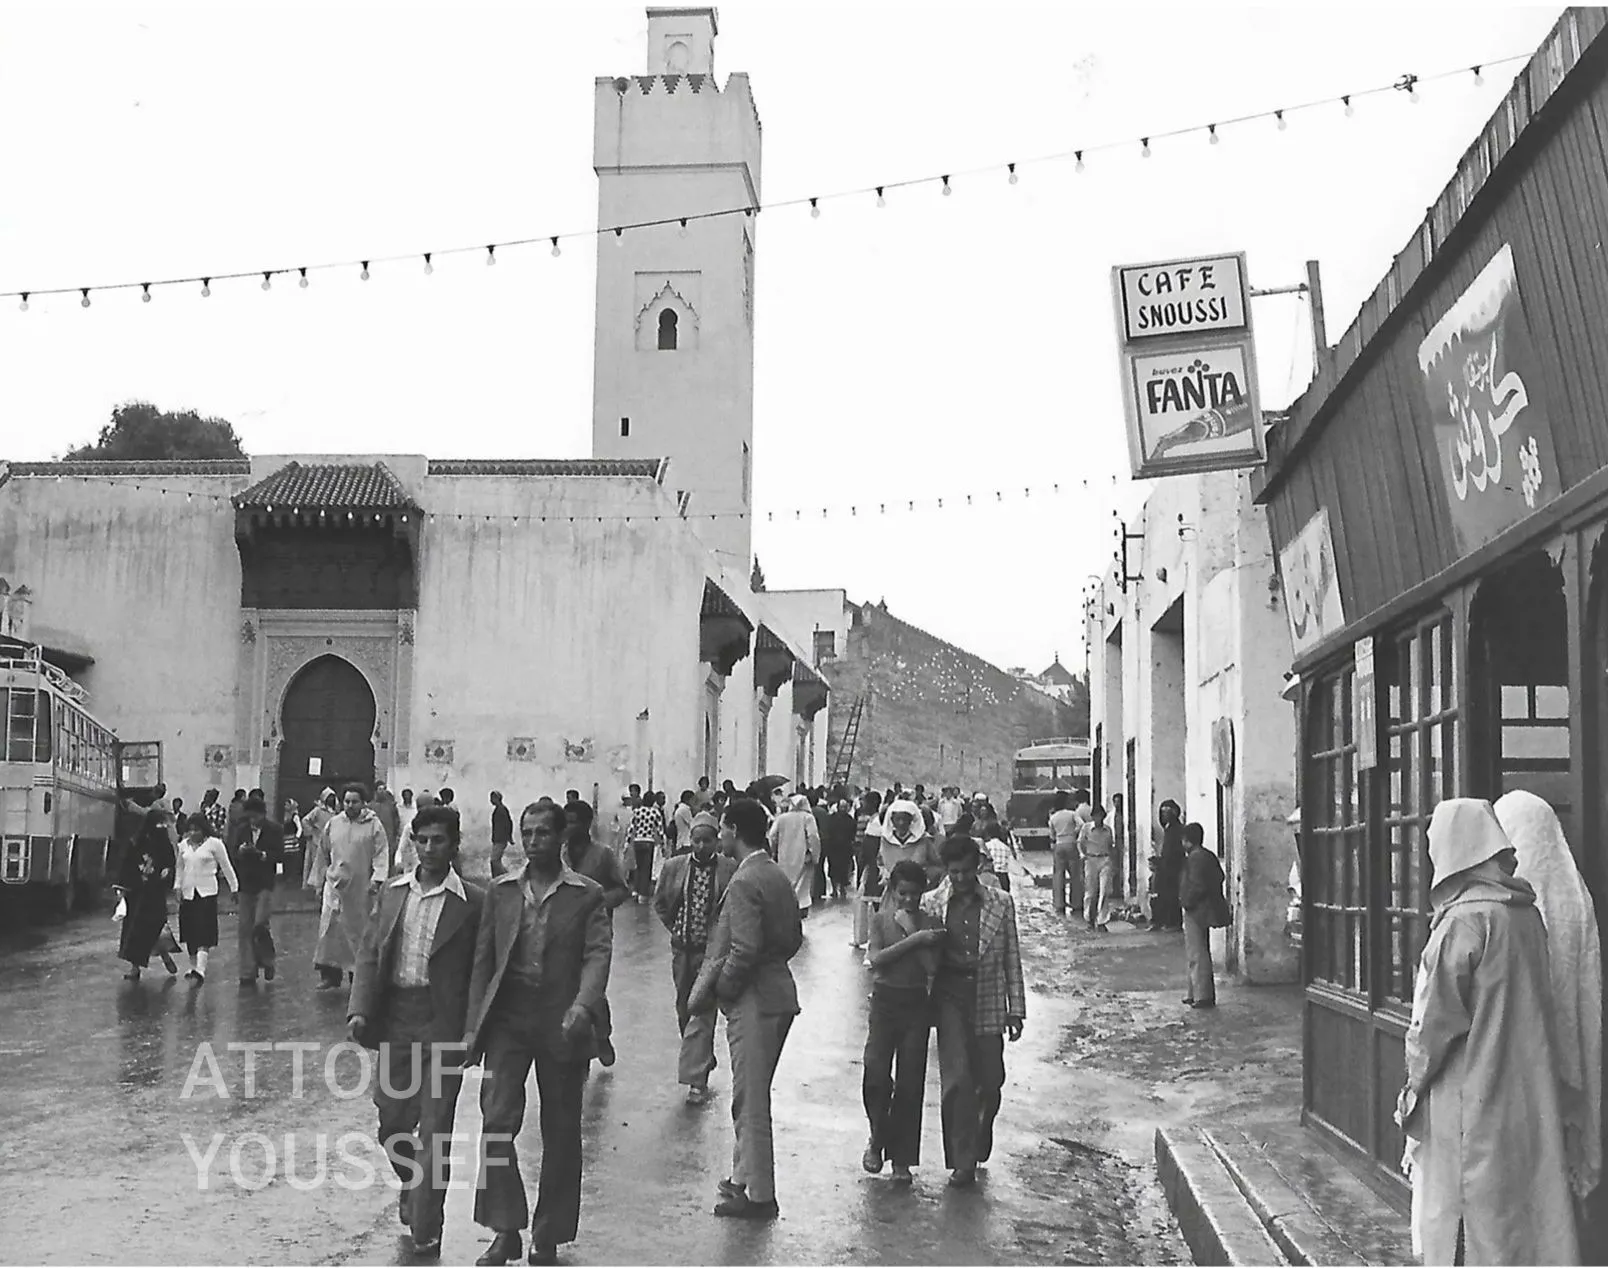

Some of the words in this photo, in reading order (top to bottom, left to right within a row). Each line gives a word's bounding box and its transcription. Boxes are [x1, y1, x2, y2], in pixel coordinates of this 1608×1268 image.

[1138, 265, 1216, 296] CAFE
[1138, 296, 1227, 329] SNOUSSI
[1147, 369, 1241, 414] FANTA
